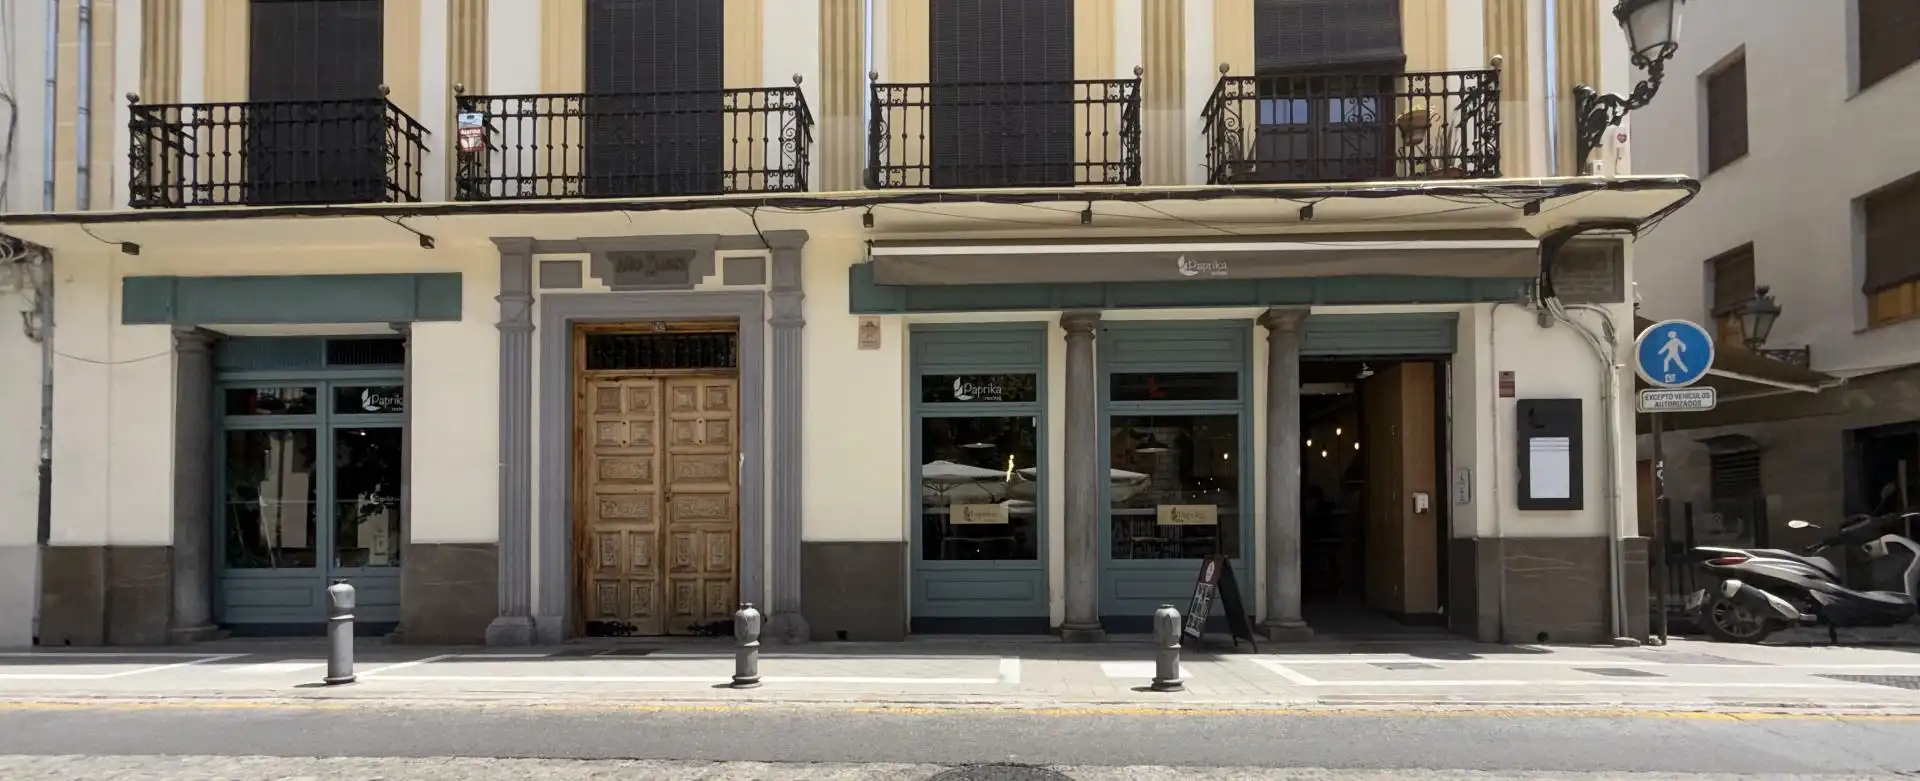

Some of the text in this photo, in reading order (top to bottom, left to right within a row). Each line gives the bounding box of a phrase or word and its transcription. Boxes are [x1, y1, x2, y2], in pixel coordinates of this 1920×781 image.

[1189, 259, 1227, 273] Paprika
[964, 382, 1002, 398] Paprika
[1645, 393, 1674, 401] EXCEPTO
[371, 393, 403, 409] Paprik
[1655, 399, 1702, 408] AUTORIZADOS
